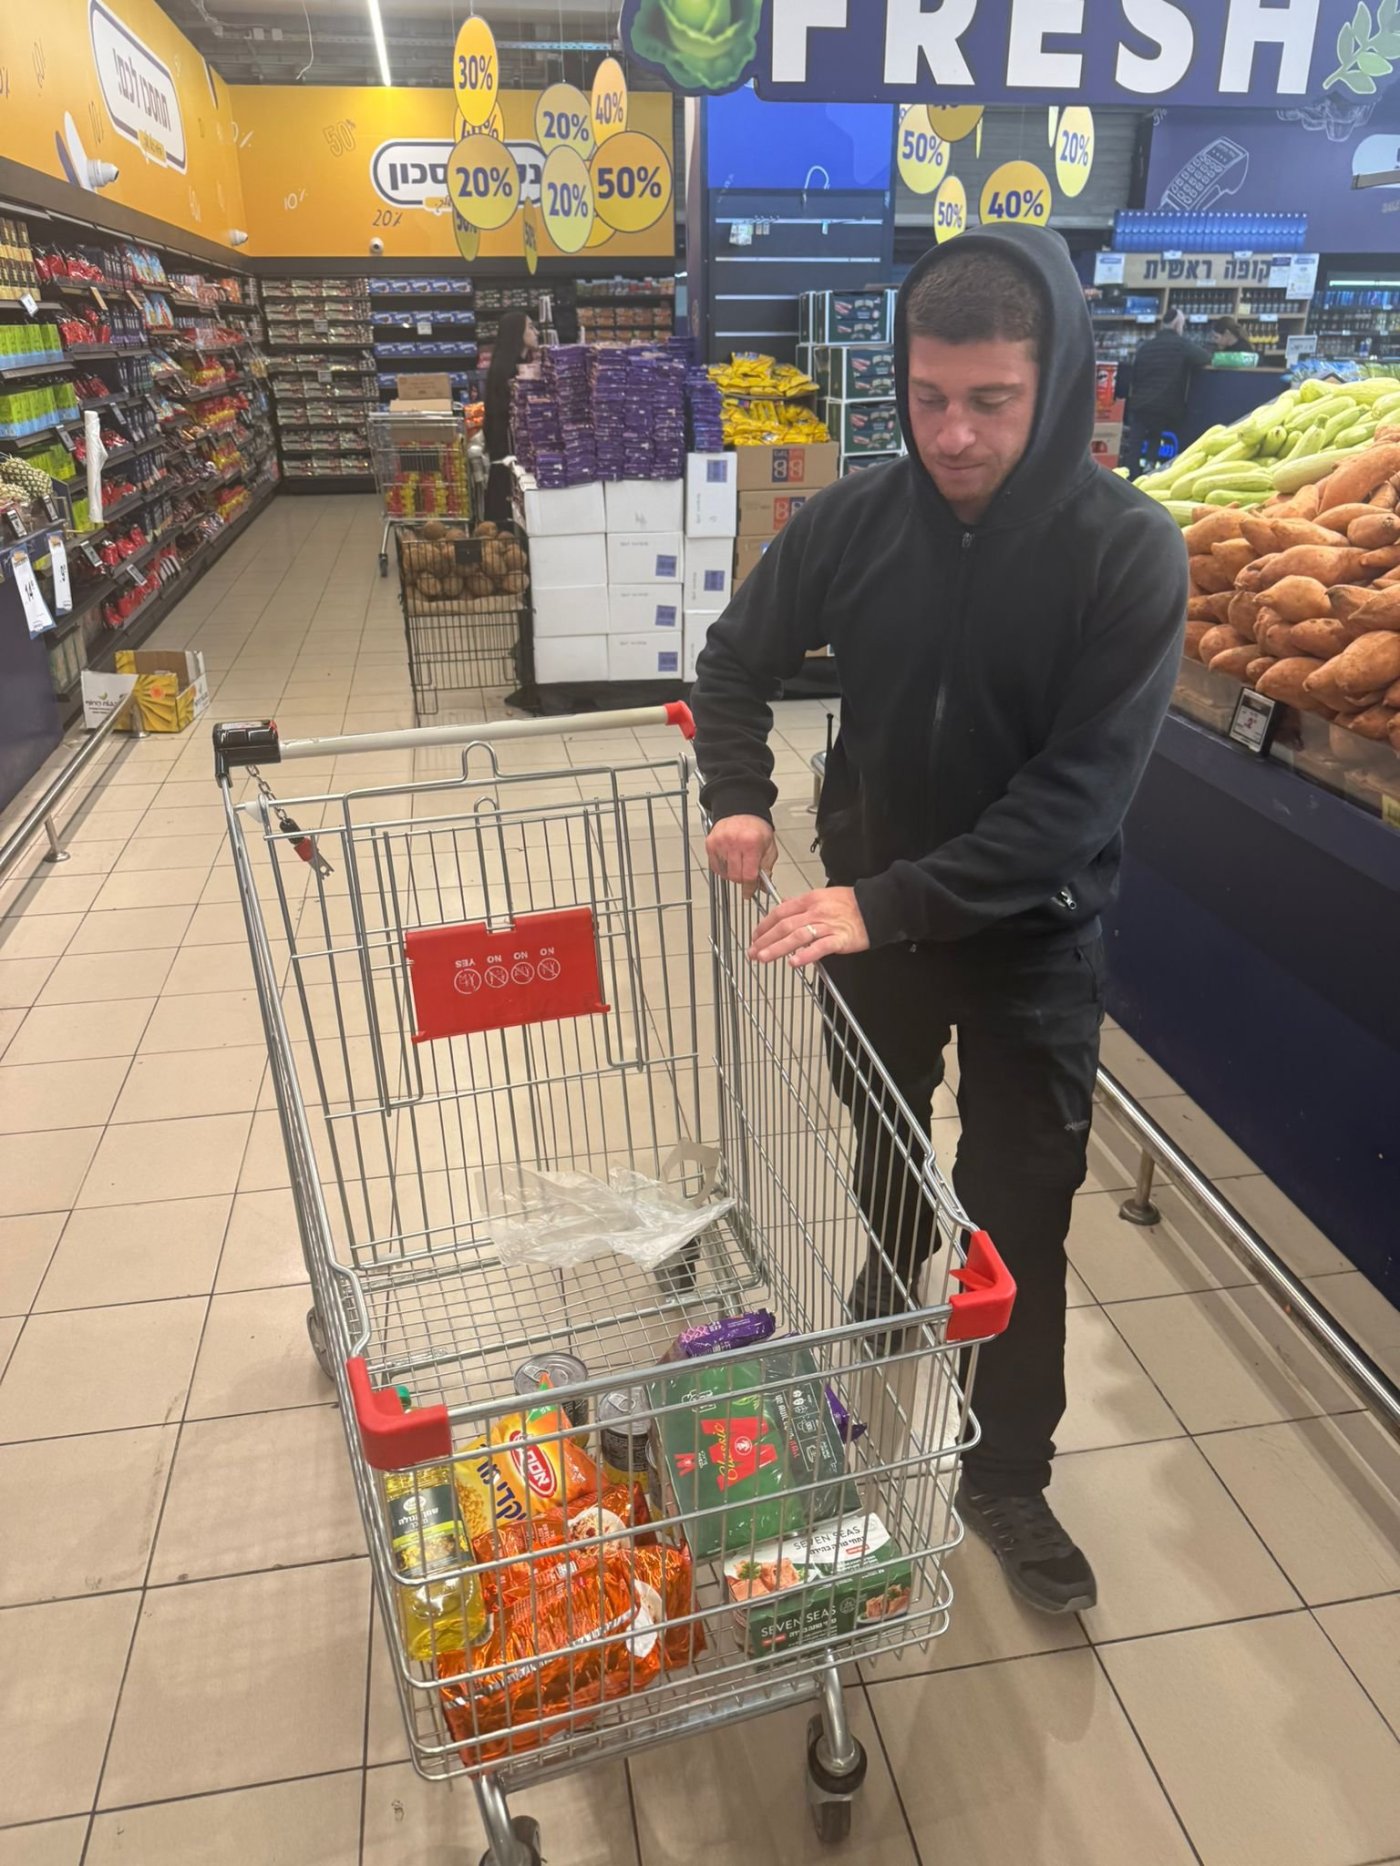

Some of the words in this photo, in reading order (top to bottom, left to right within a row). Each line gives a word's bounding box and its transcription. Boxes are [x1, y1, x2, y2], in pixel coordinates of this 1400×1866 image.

[771, 0, 1319, 96] FRESH
[458, 54, 493, 91] 30%
[595, 91, 624, 126] 40%
[543, 110, 590, 142] 20%
[902, 130, 944, 167] 50%
[1060, 130, 1091, 167] 20%
[389, 163, 448, 191] סכון
[455, 167, 513, 198] 20%
[597, 165, 662, 200] 50%
[547, 182, 589, 219] 20%
[937, 201, 963, 230] 50%
[988, 189, 1044, 219] 40%
[1143, 259, 1213, 280] ראשית
[1224, 260, 1272, 284] קופה
[455, 959, 476, 968] YES
[487, 954, 502, 964] NO
[513, 951, 529, 961] NO
[539, 947, 555, 957] NO
[833, 1525, 861, 1542] SEAS
[761, 1617, 801, 1637] SEVEN
[807, 1605, 836, 1622] SEAS
